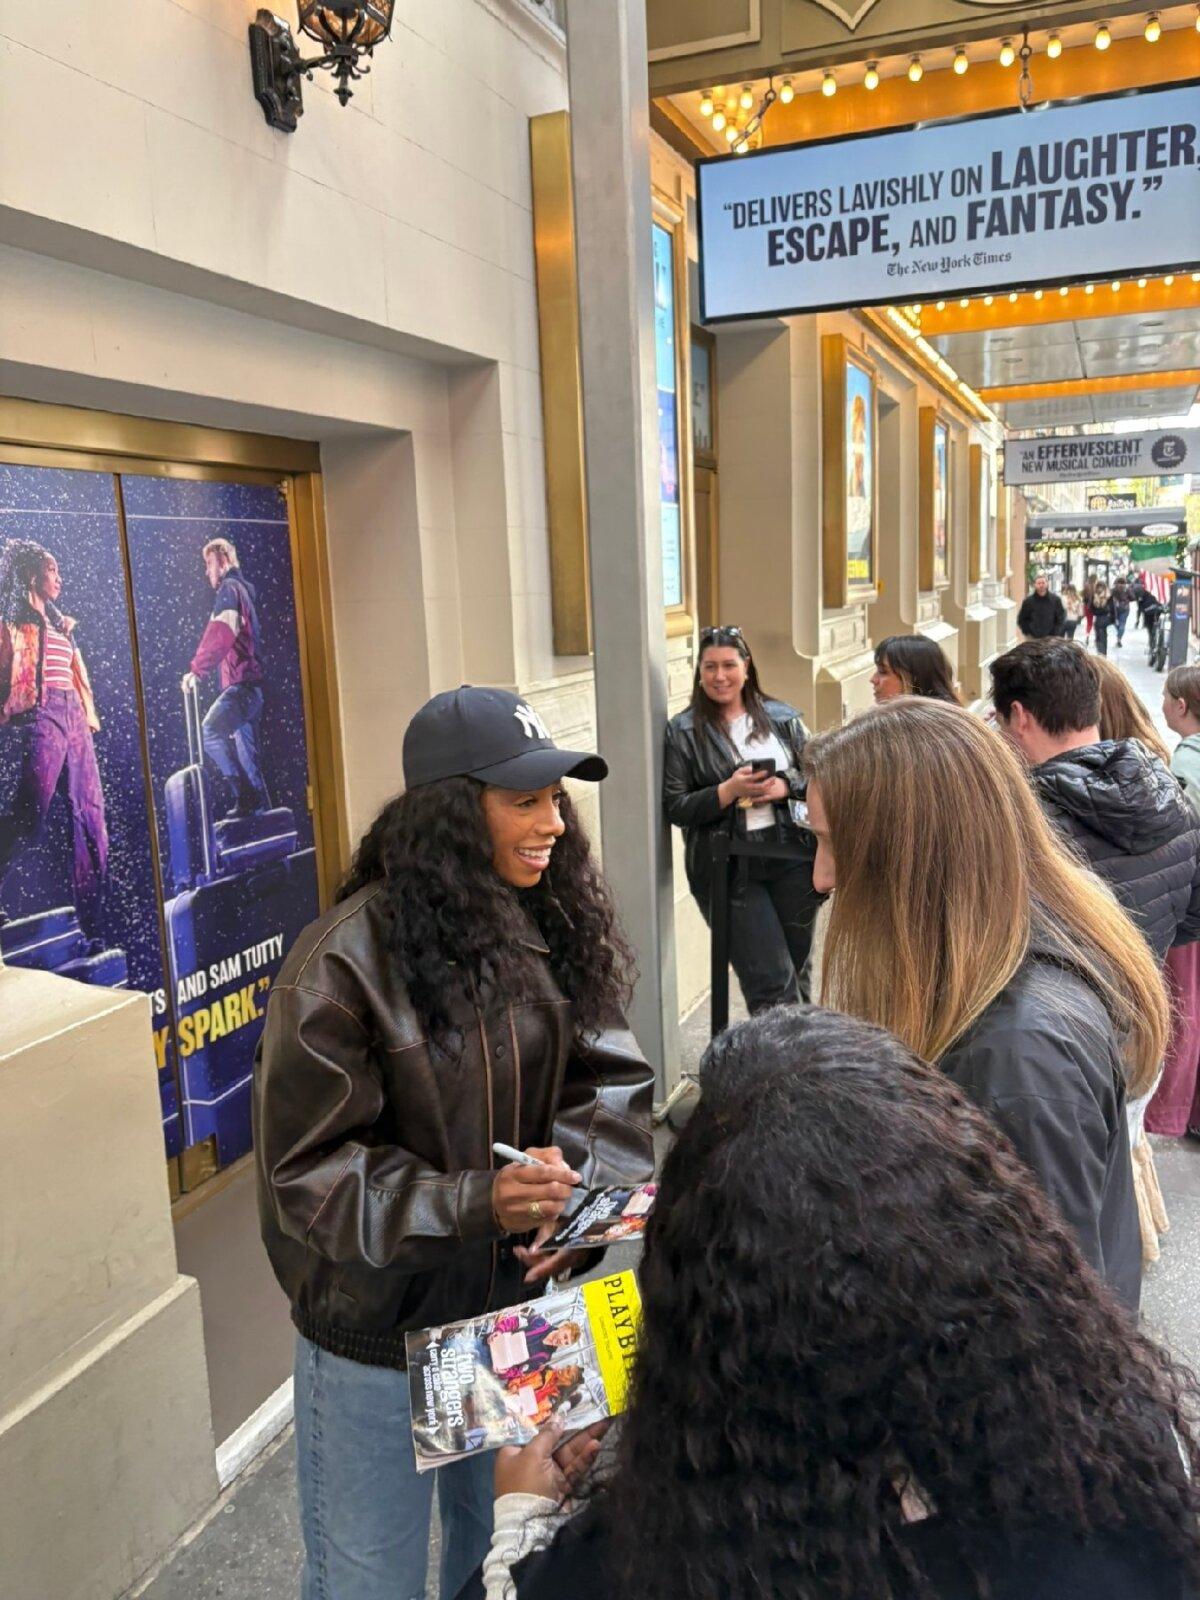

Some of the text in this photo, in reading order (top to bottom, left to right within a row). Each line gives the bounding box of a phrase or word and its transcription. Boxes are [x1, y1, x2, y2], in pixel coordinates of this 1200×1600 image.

[723, 188, 833, 230] “DELIVERS
[838, 170, 945, 214] LAVISHLY
[950, 164, 983, 197] ON
[767, 175, 1163, 267] ESCAPE, AND FANTASY.”
[886, 251, 1012, 277] The New York Times
[1022, 459, 1044, 473] NEW
[1046, 456, 1089, 472] MUSICAL
[1037, 438, 1143, 460] EFFERVESCENT
[177, 970, 207, 1006] AND
[209, 953, 241, 988] SAM
[242, 933, 284, 973] TUTTY
[177, 976, 271, 1058] SPARK.”
[603, 1277, 638, 1380] PLAYBI
[422, 1365, 439, 1426] across new york
[440, 1348, 464, 1428] strangers
[457, 1352, 476, 1385] two
